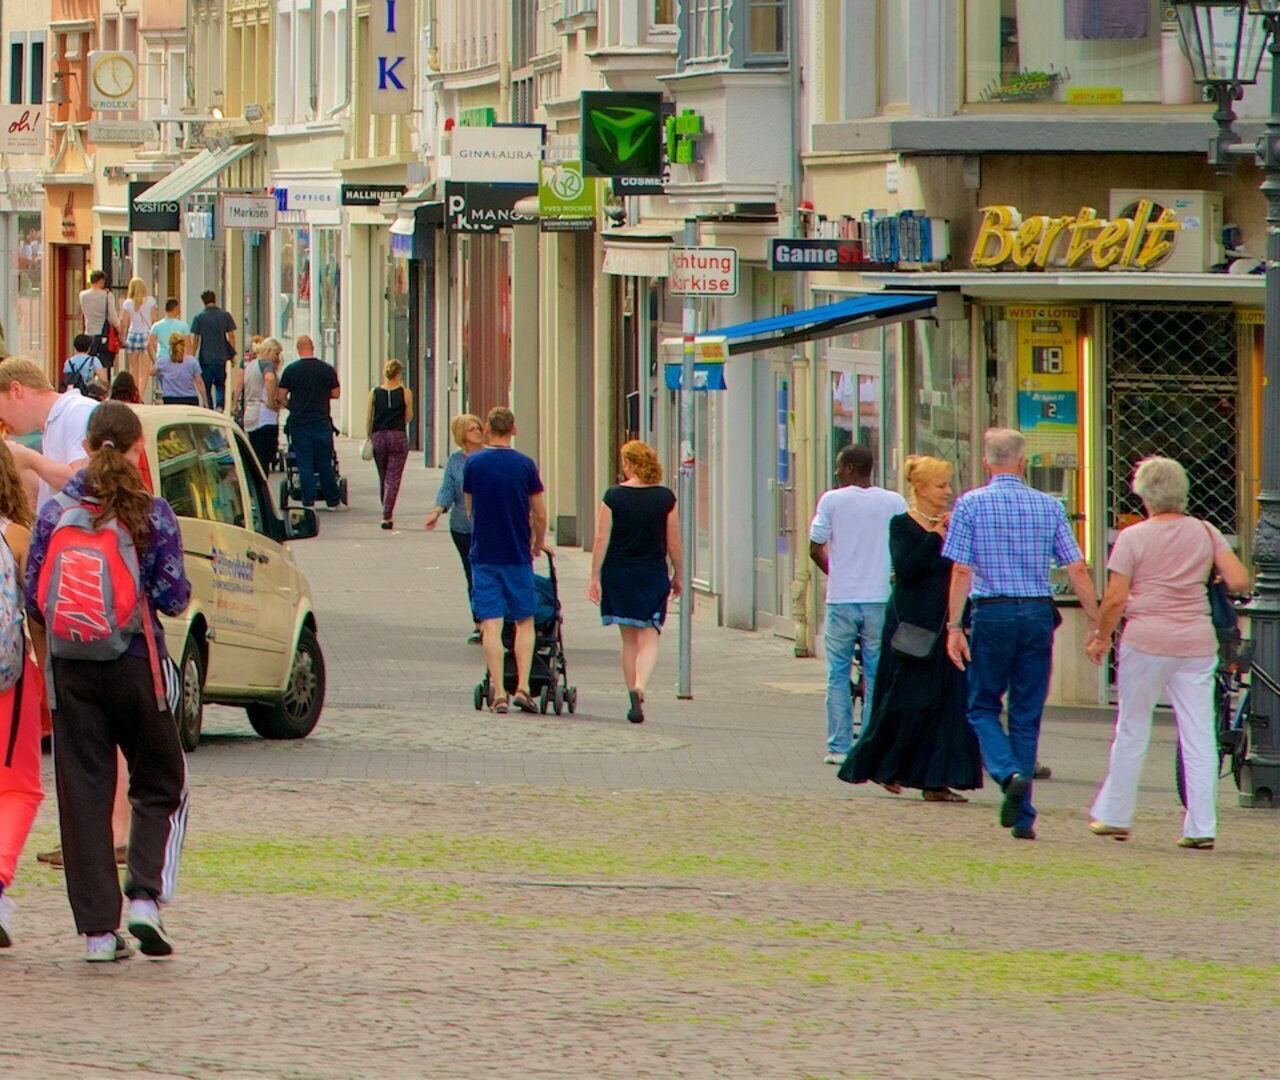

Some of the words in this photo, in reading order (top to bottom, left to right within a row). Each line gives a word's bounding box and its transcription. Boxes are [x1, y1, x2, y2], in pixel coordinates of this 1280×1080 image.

[459, 149, 533, 159] GINALAURA
[294, 194, 332, 202] OFFICE
[345, 190, 403, 200] HALLHUBER
[132, 200, 179, 214] vestino
[970, 198, 1183, 269] Bertelt
[775, 244, 870, 264] GameSt
[1009, 308, 1038, 318] WEST
[1047, 308, 1079, 318] LOTTO
